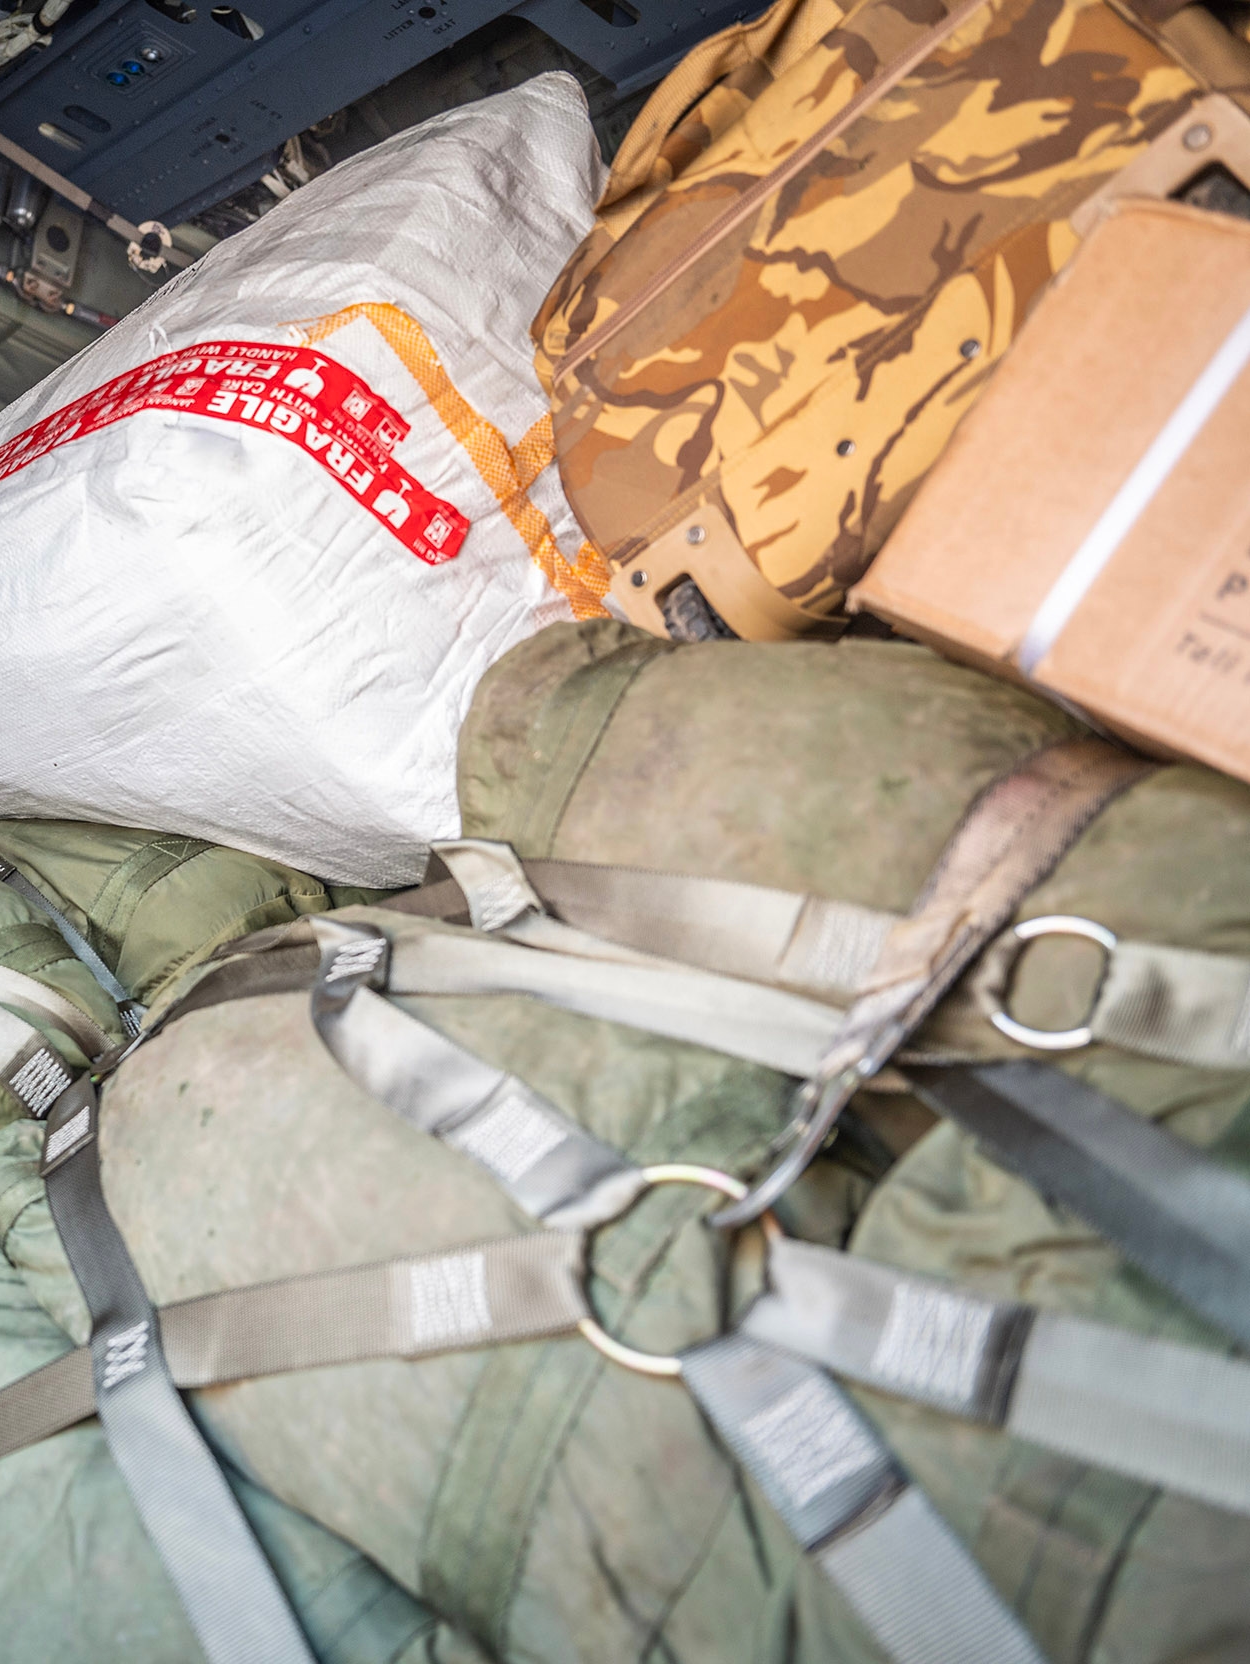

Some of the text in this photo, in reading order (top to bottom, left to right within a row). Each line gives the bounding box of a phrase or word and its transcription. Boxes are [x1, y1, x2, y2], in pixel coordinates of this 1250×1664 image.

[226, 345, 299, 361] HANDLE
[134, 358, 281, 388] FRAGILE
[219, 378, 318, 419] WITH CARE
[206, 390, 376, 495] FRAGILE
